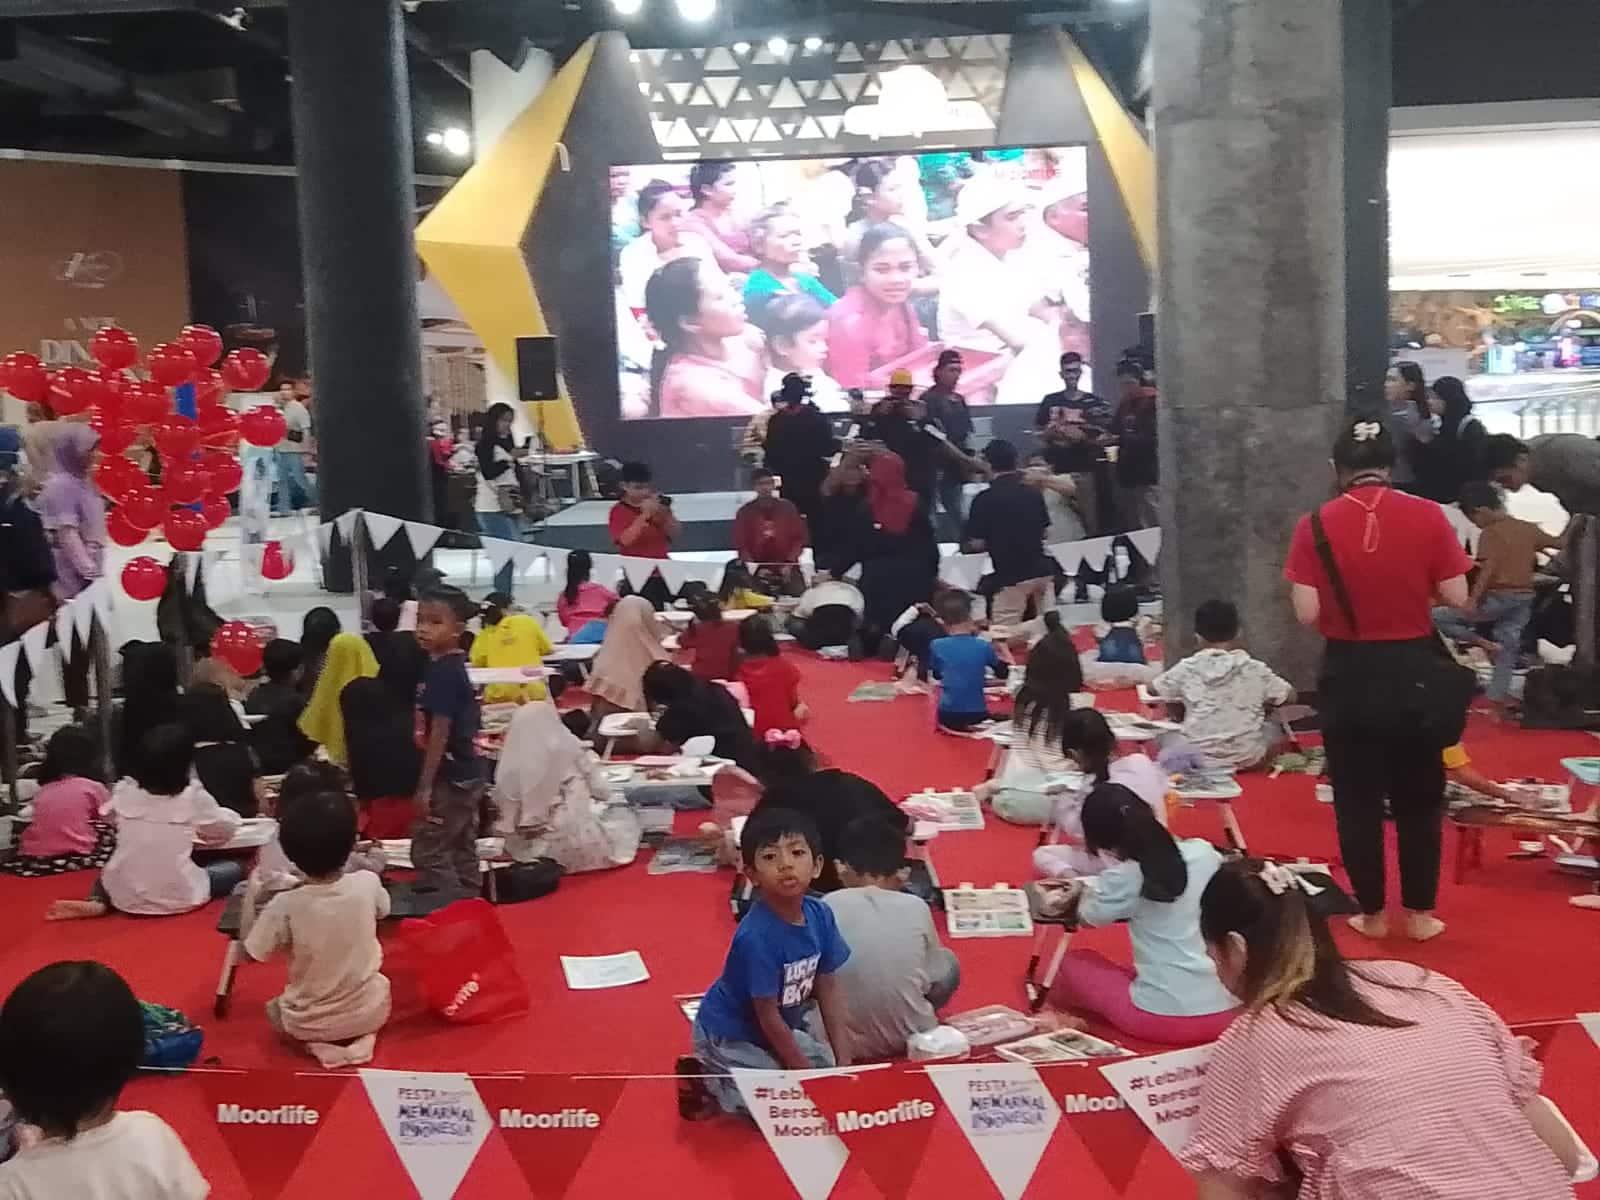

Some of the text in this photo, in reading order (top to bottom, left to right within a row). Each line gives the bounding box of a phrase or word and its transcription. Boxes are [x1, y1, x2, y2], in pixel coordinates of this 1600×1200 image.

[217, 1103, 320, 1125] Moorlife
[499, 1108, 600, 1128] Moorlife
[835, 1099, 936, 1133] Moorlife
